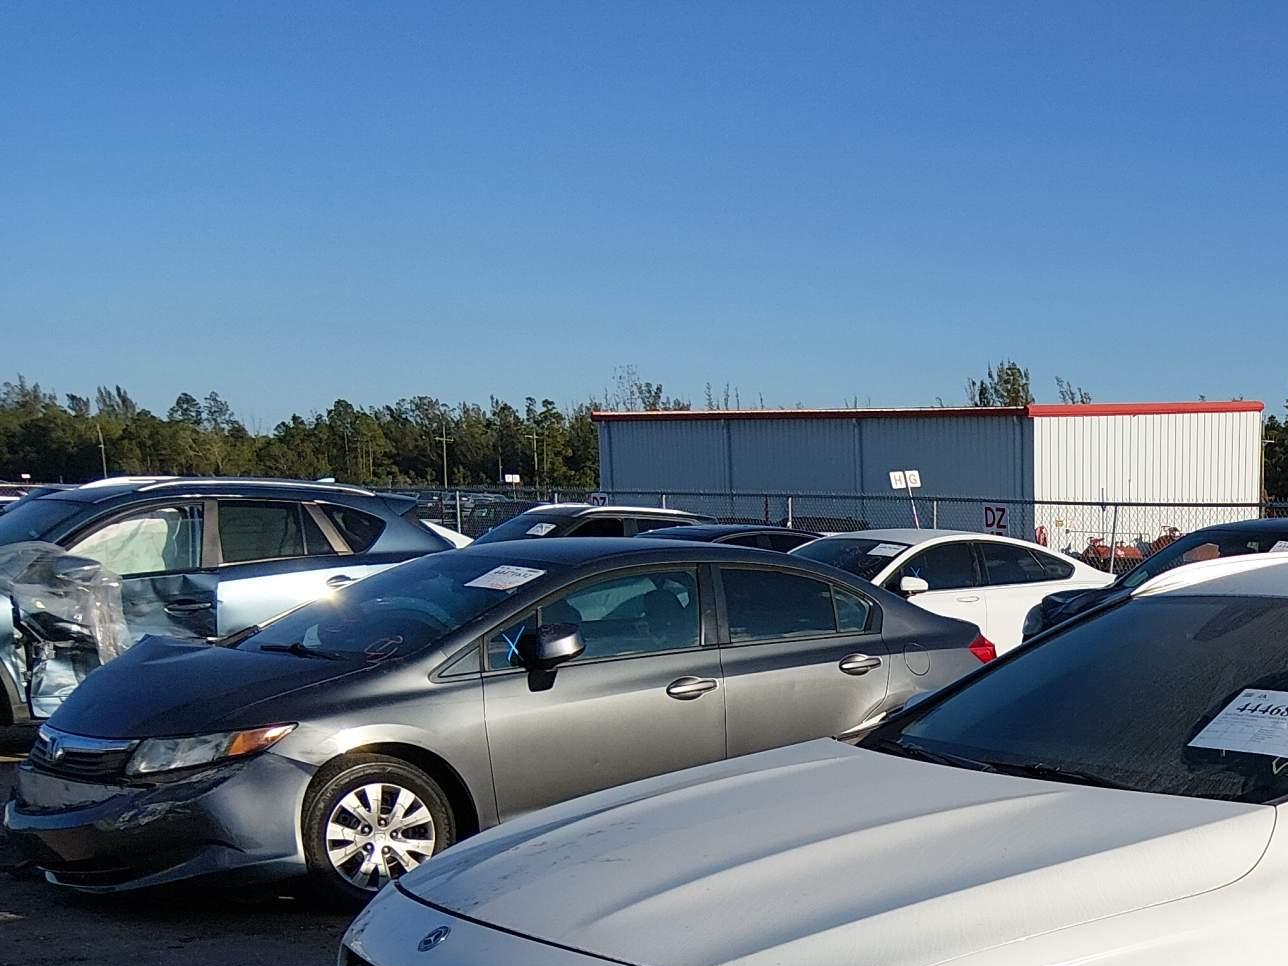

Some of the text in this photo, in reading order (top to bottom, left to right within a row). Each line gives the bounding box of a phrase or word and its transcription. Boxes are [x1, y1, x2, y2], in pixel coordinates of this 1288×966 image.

[894, 475, 903, 486] H
[909, 474, 917, 485] G
[984, 507, 1006, 528] DZ
